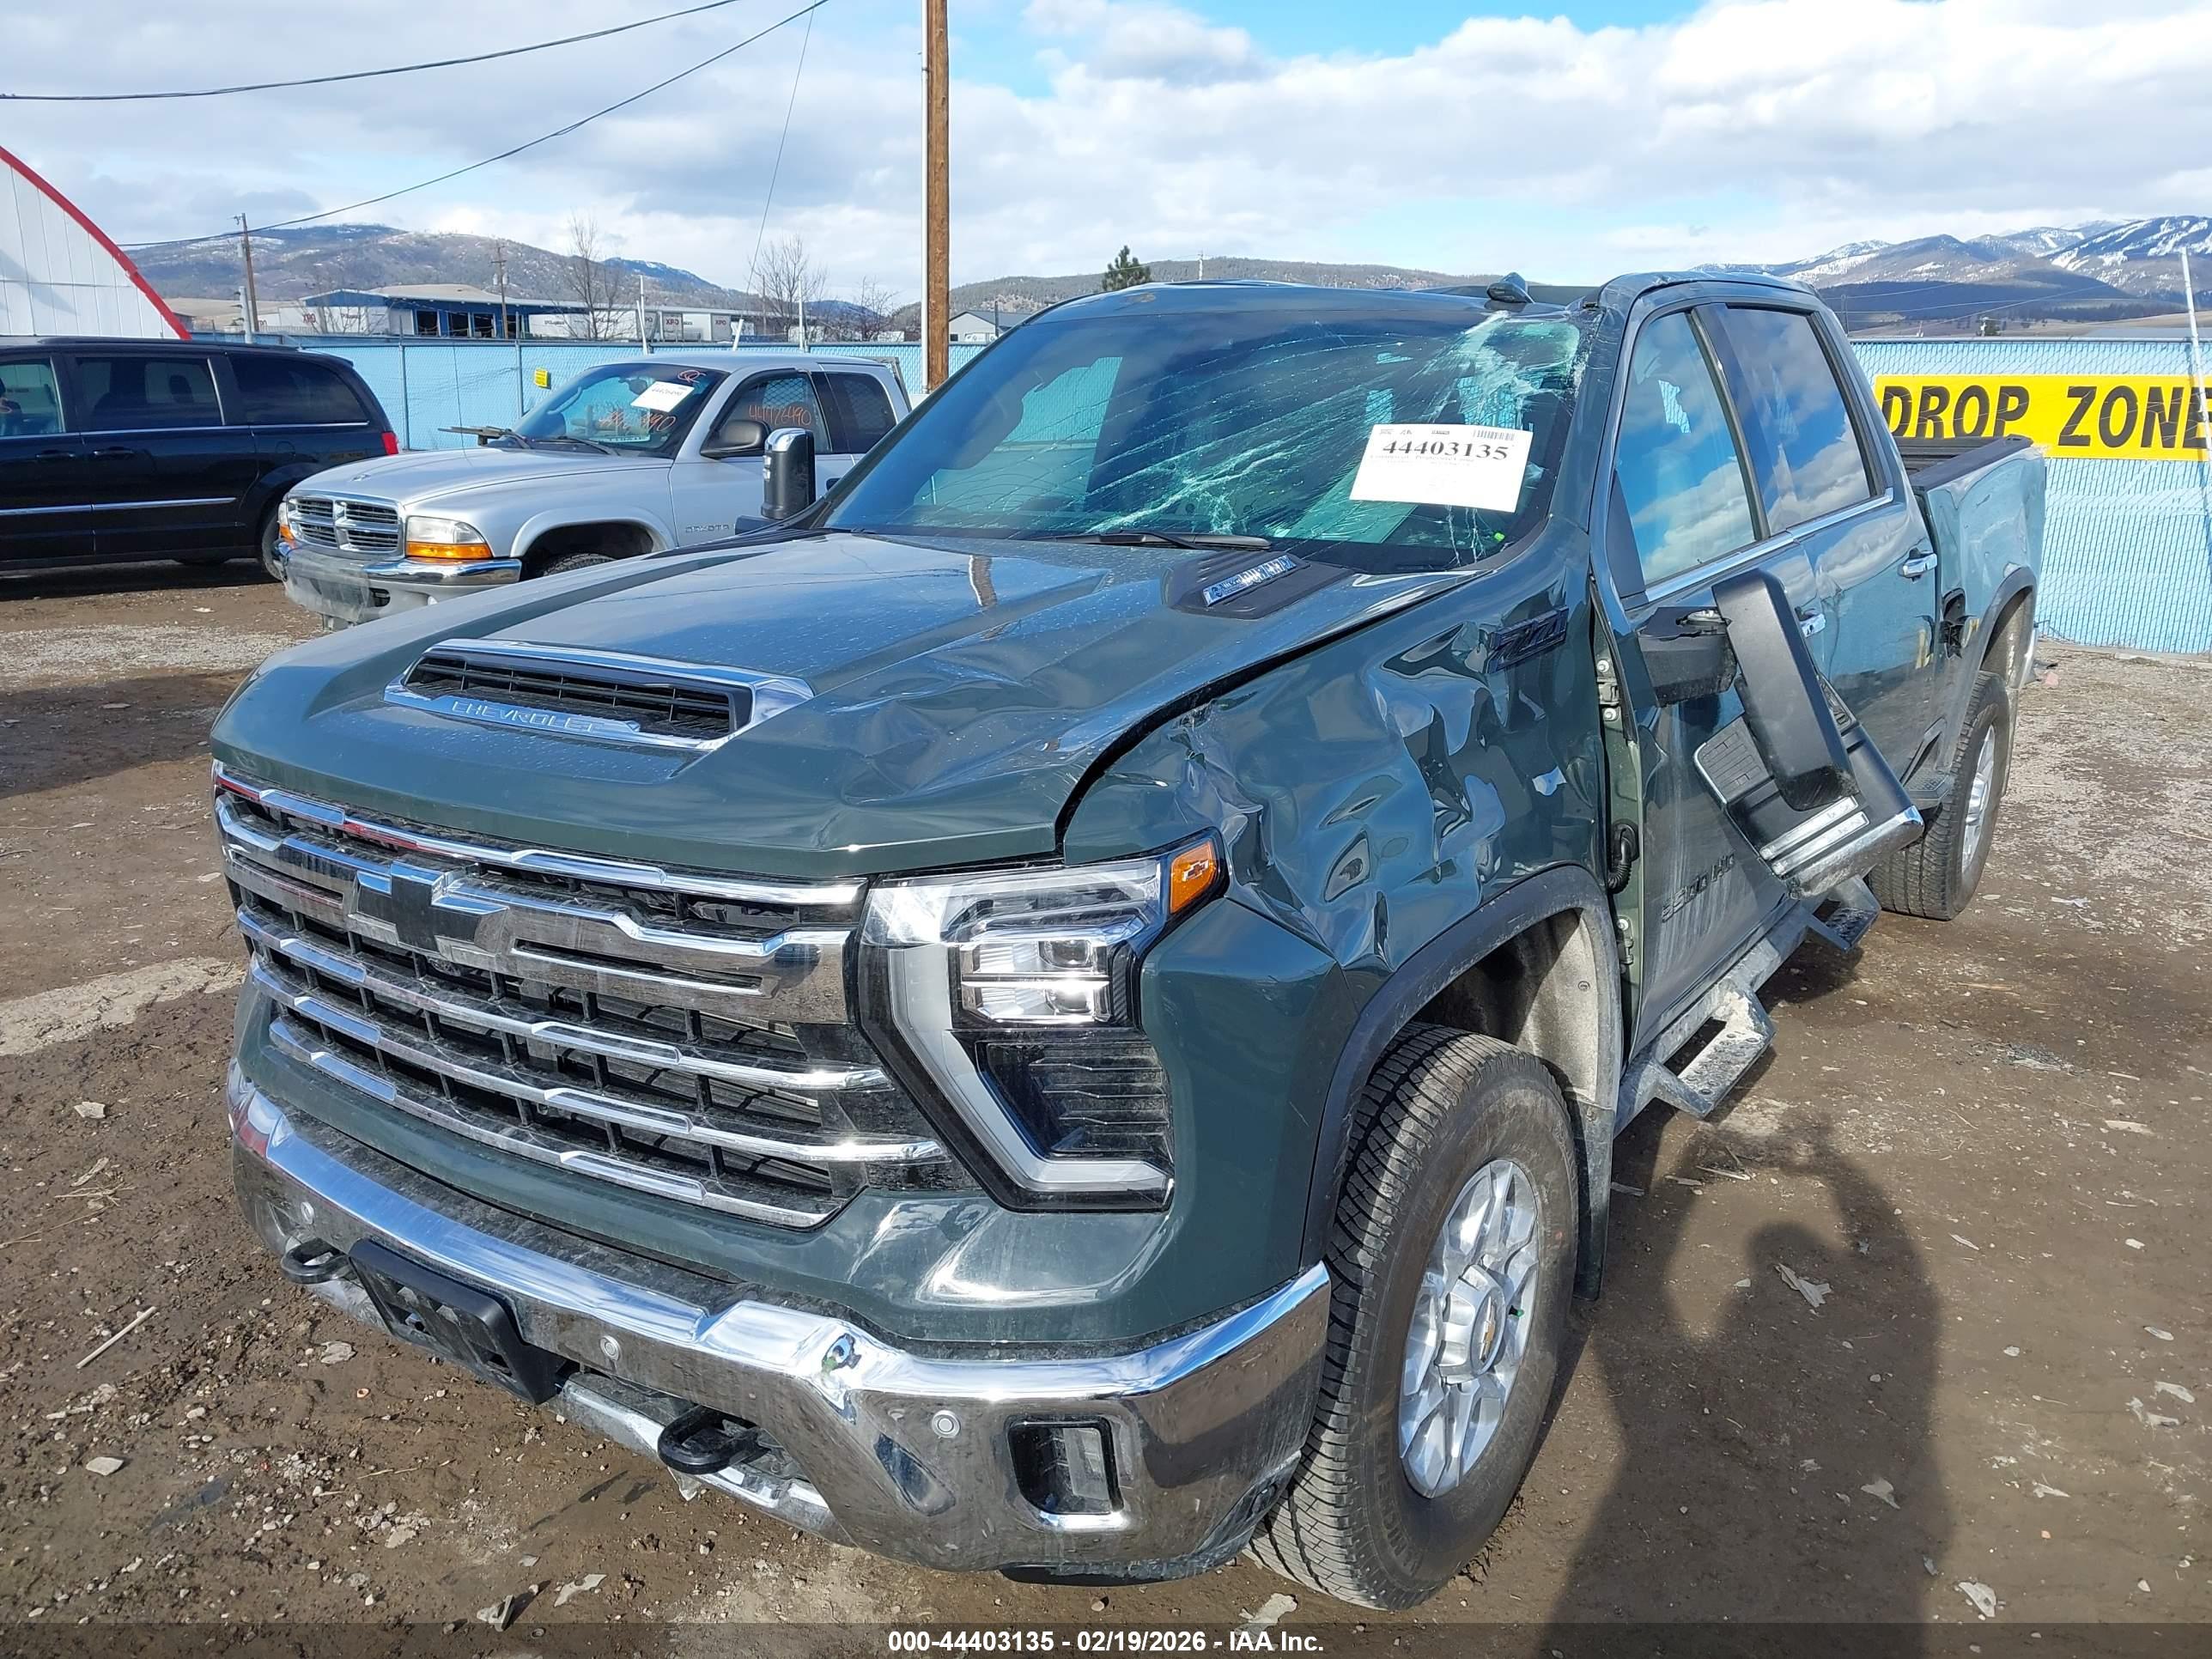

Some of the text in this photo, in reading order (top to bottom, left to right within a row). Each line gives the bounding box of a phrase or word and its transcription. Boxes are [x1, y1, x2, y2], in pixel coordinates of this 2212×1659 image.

[1881, 386, 2212, 448] DROP ZONE
[1382, 441, 1509, 460] 44403135
[452, 700, 605, 732] CHEVROLET
